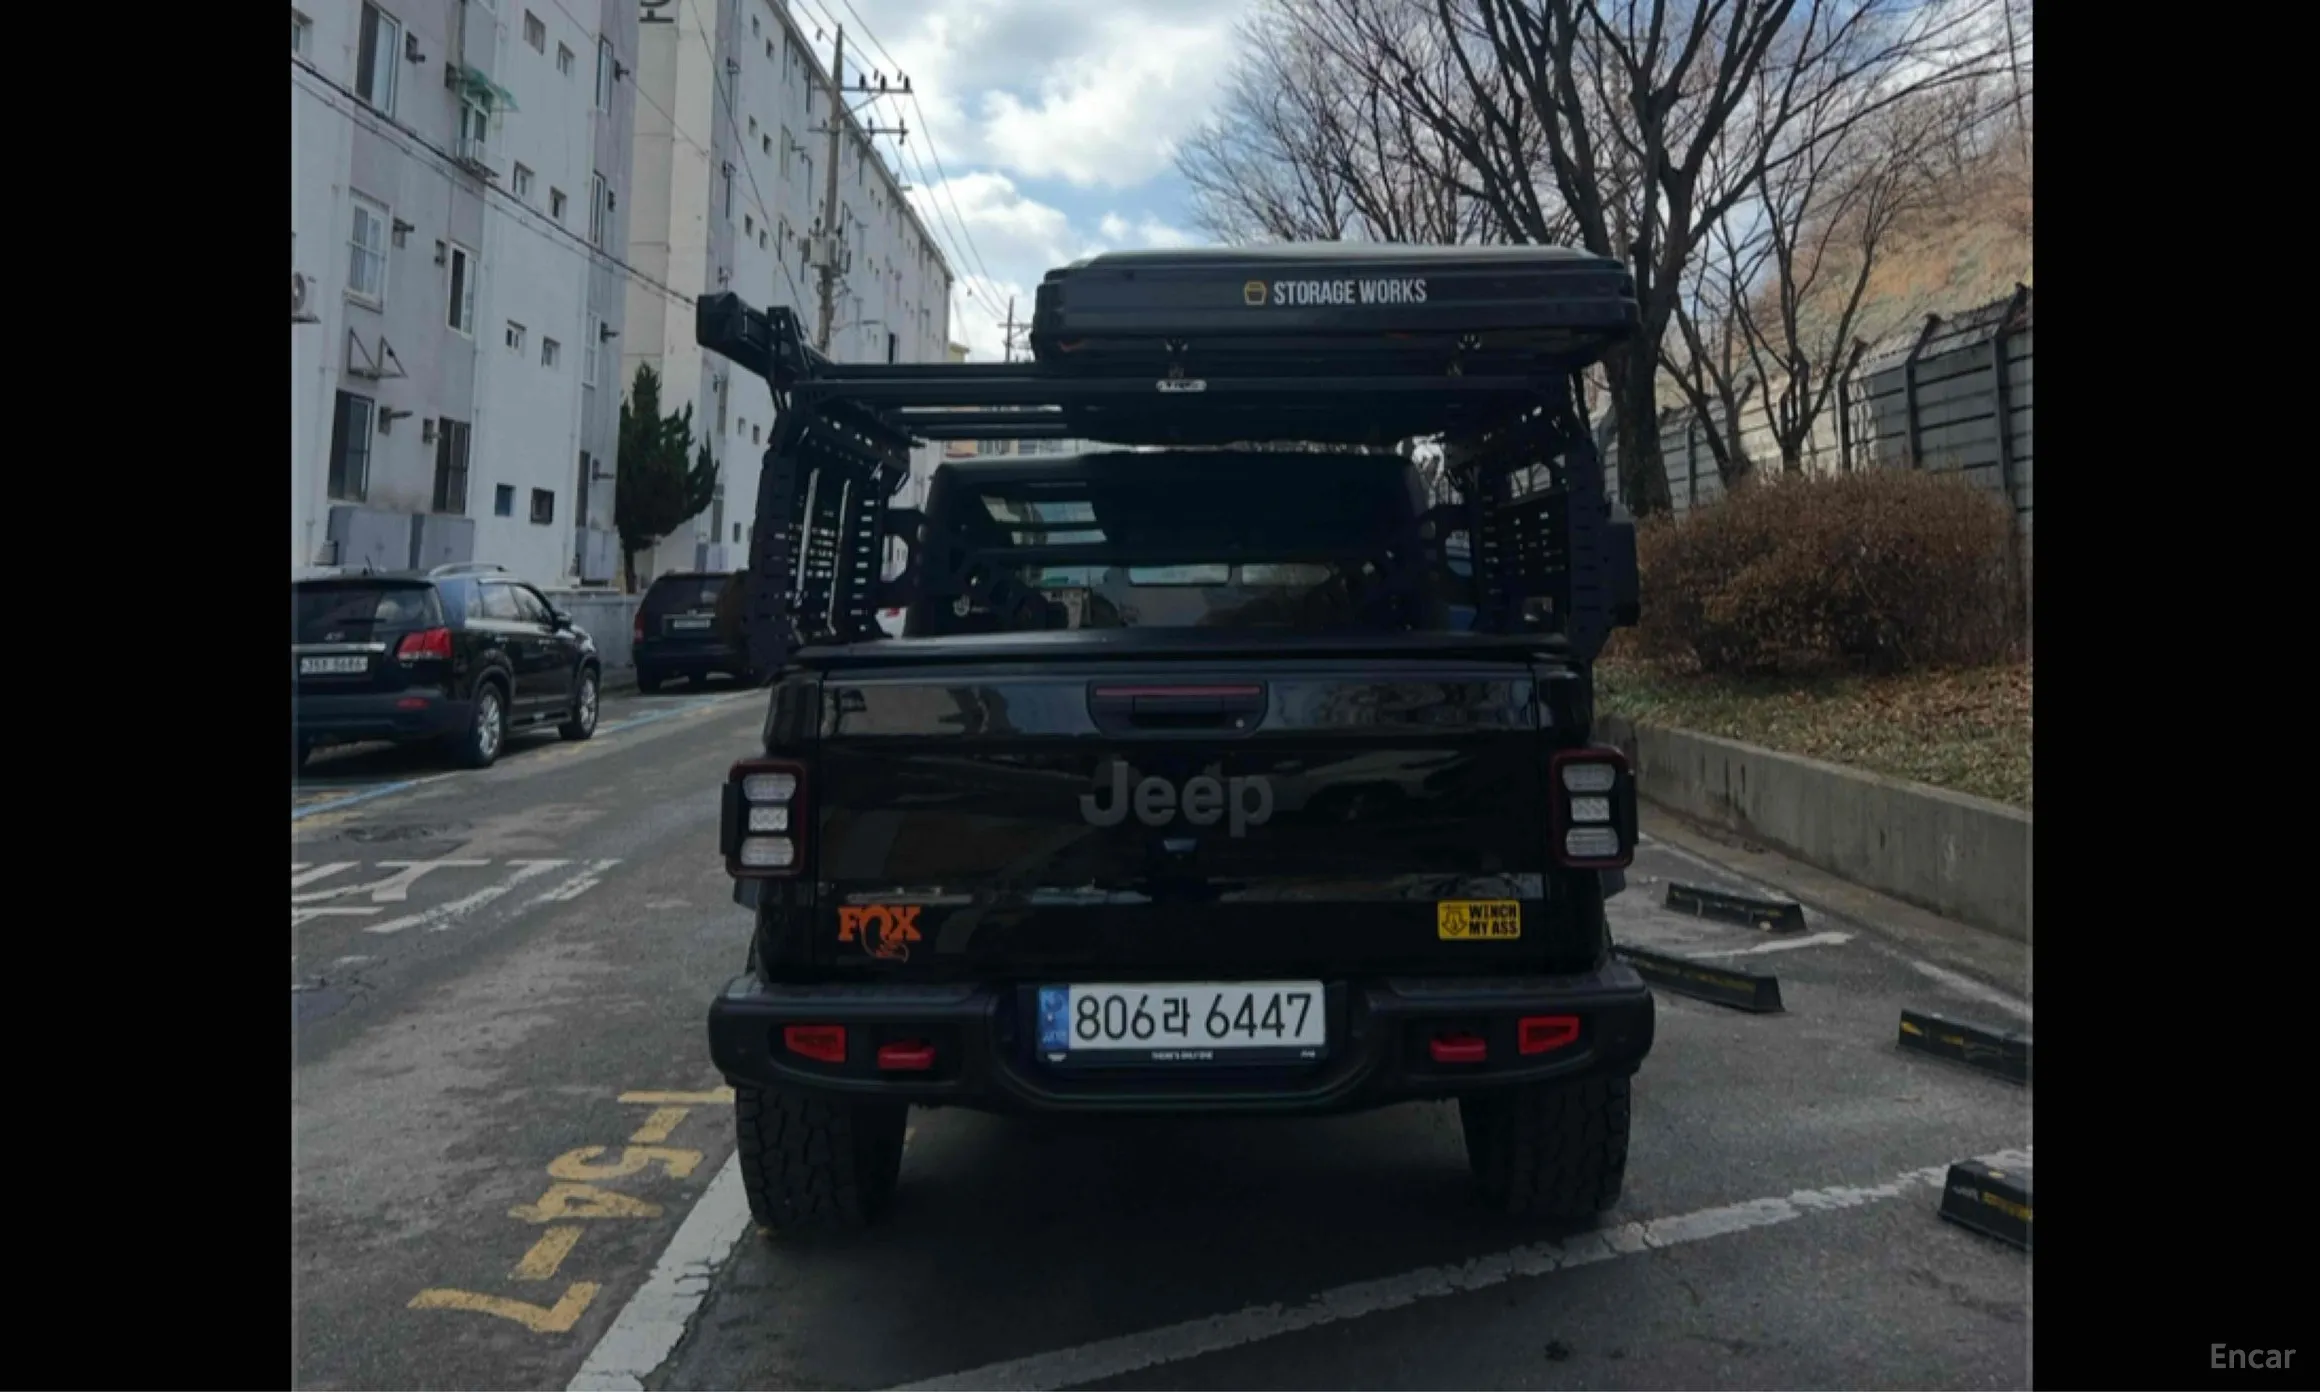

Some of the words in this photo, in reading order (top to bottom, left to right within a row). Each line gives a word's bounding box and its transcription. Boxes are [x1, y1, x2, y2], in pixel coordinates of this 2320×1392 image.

[1273, 280, 1356, 305] STORAGE
[1359, 278, 1427, 304] WORKS
[1079, 761, 1274, 838] Jeep
[1469, 903, 1517, 918] WINCH
[1469, 921, 1488, 936] MY
[1492, 921, 1518, 936] ASS
[838, 904, 922, 960] FOX
[1075, 994, 1190, 1040] 806라
[1205, 993, 1312, 1038] 6447
